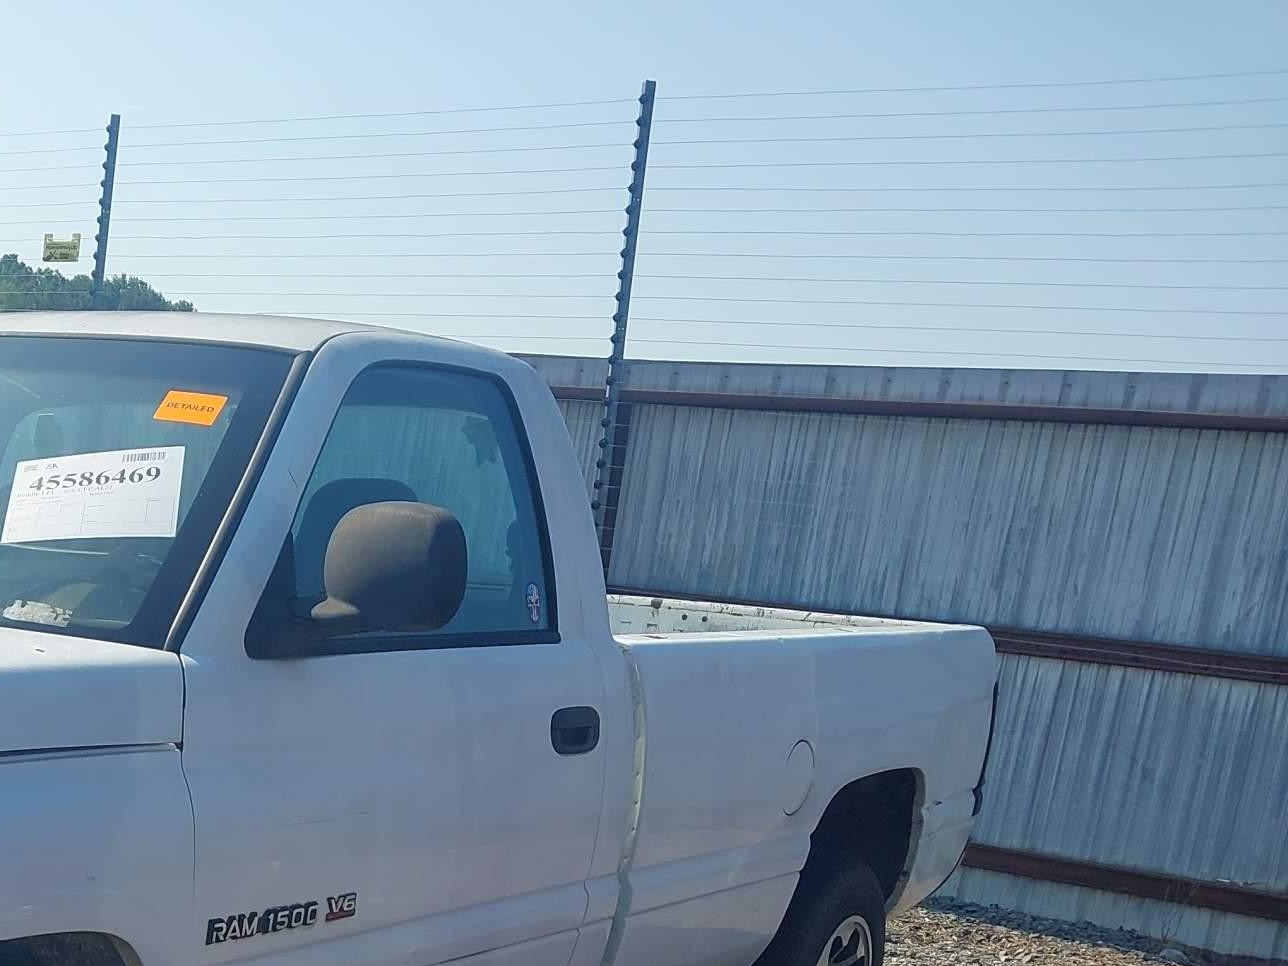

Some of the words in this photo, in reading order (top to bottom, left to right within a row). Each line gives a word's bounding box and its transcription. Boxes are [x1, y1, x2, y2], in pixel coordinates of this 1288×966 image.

[166, 402, 215, 412] DETAILED
[29, 466, 161, 491] 45586469
[207, 912, 258, 945] RAM
[262, 902, 318, 934] 1500
[326, 893, 357, 918] V6
